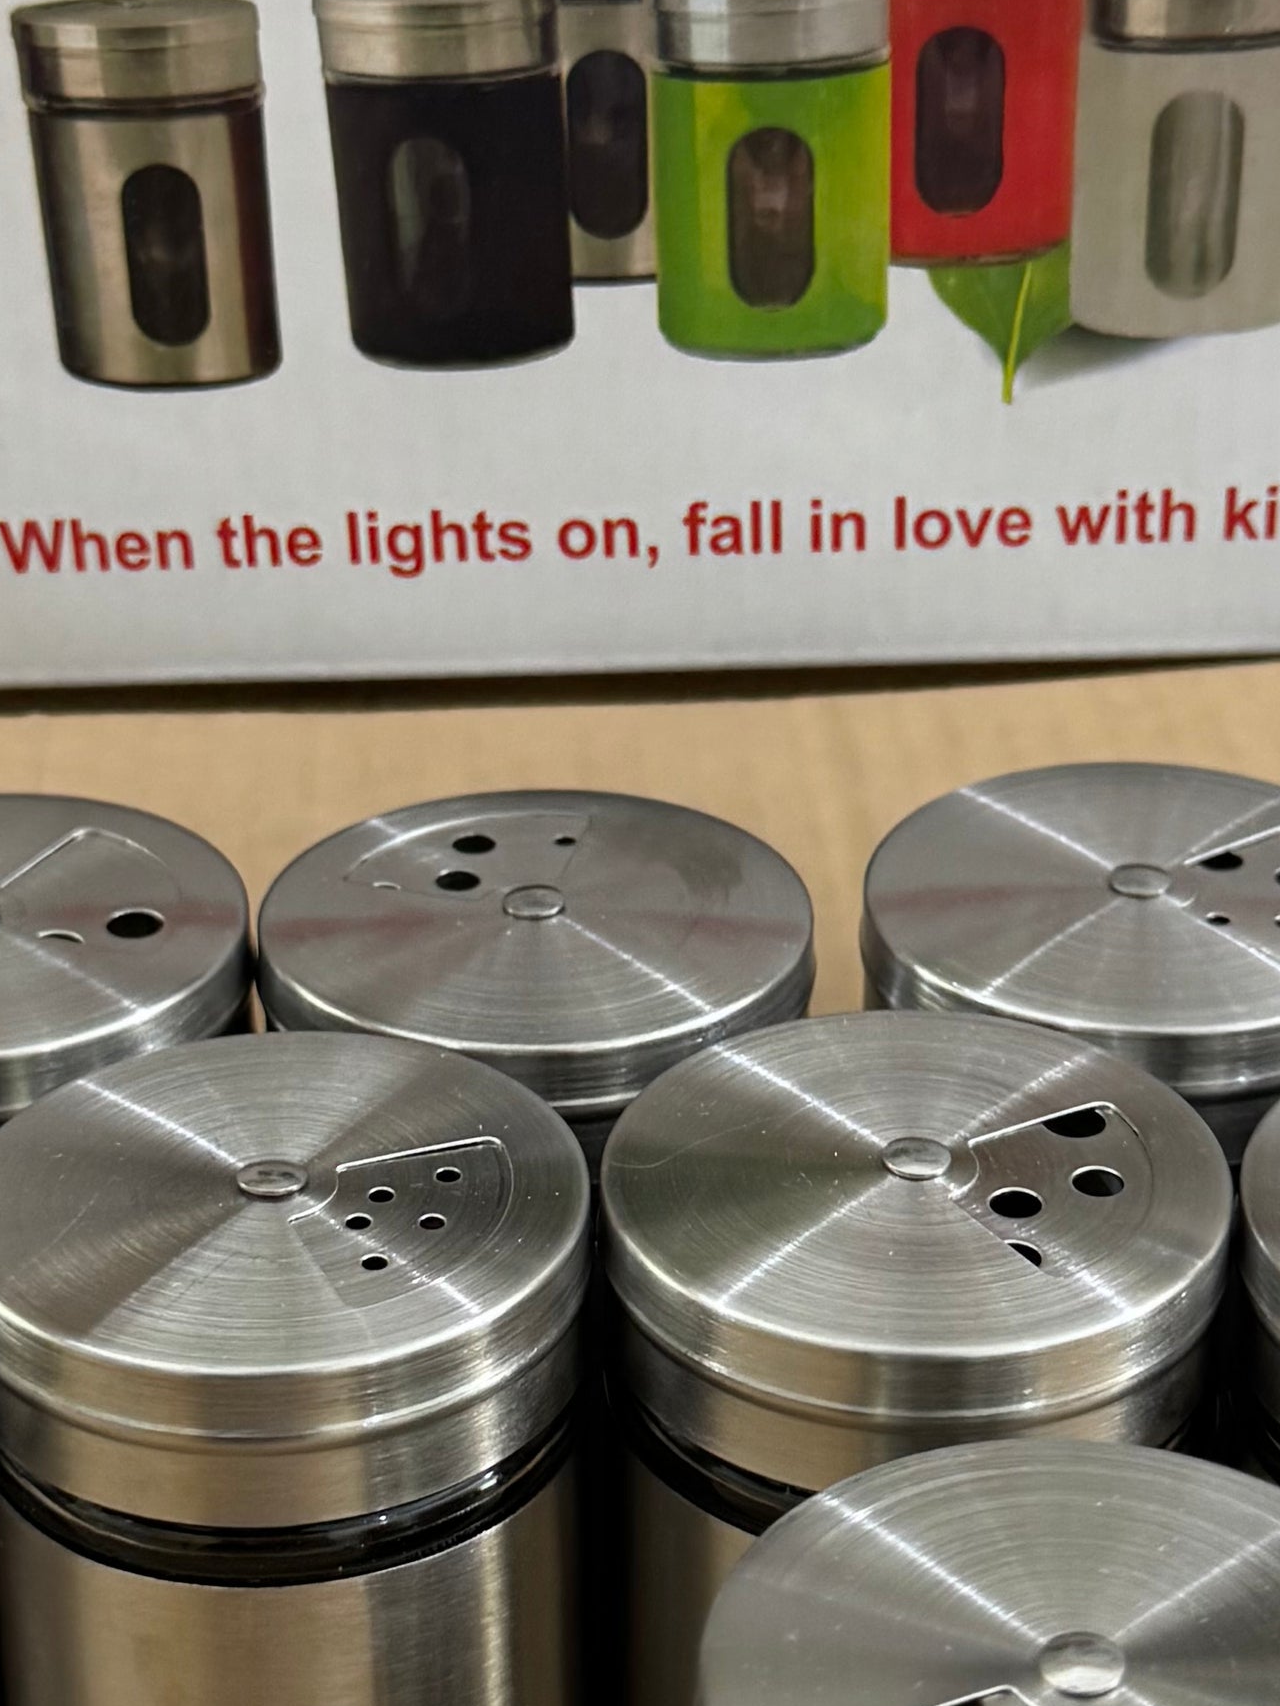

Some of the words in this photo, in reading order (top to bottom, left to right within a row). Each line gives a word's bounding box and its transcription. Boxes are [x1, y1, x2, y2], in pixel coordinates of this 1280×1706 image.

[214, 513, 324, 569] the
[345, 508, 534, 580] lights
[556, 517, 660, 569] on,
[681, 500, 784, 557] fall
[808, 498, 868, 555] in
[893, 495, 1034, 552] love
[1055, 487, 1198, 546] with
